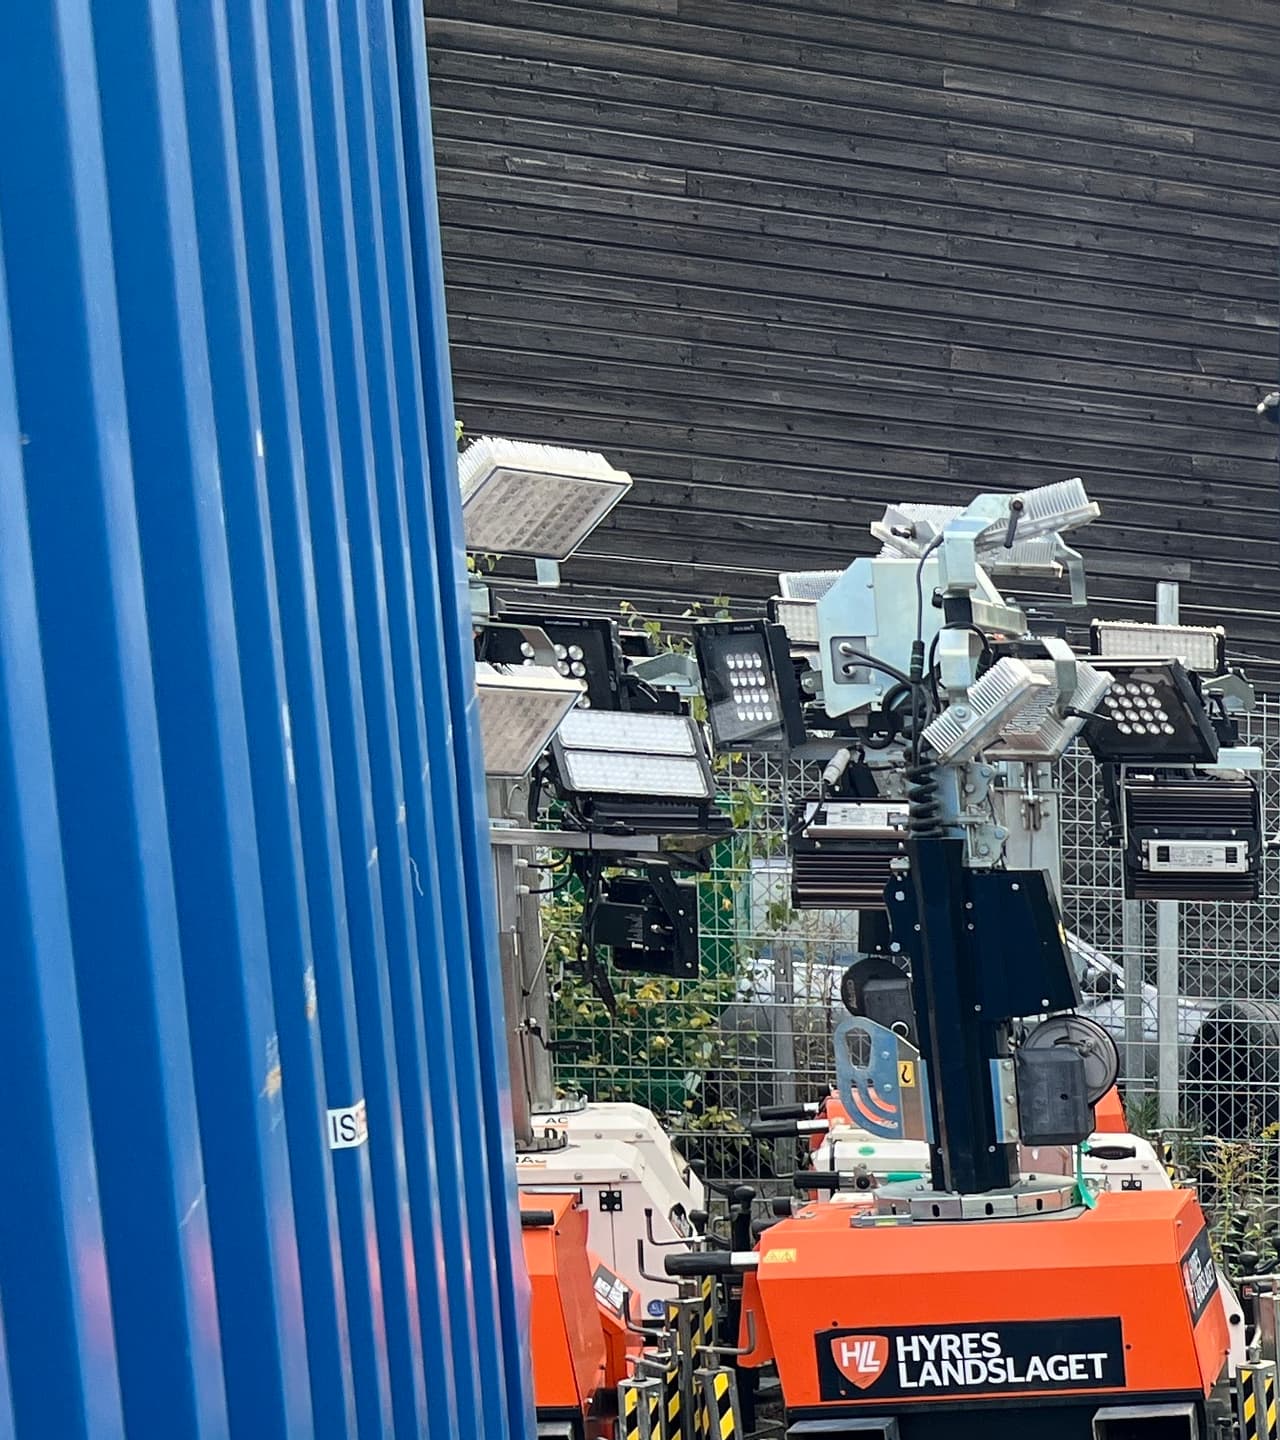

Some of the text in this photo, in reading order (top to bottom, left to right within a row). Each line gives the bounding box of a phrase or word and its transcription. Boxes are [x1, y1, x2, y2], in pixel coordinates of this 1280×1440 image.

[841, 1331, 1001, 1373] HLL HYRES
[899, 1353, 1109, 1389] LANDSLAGET
